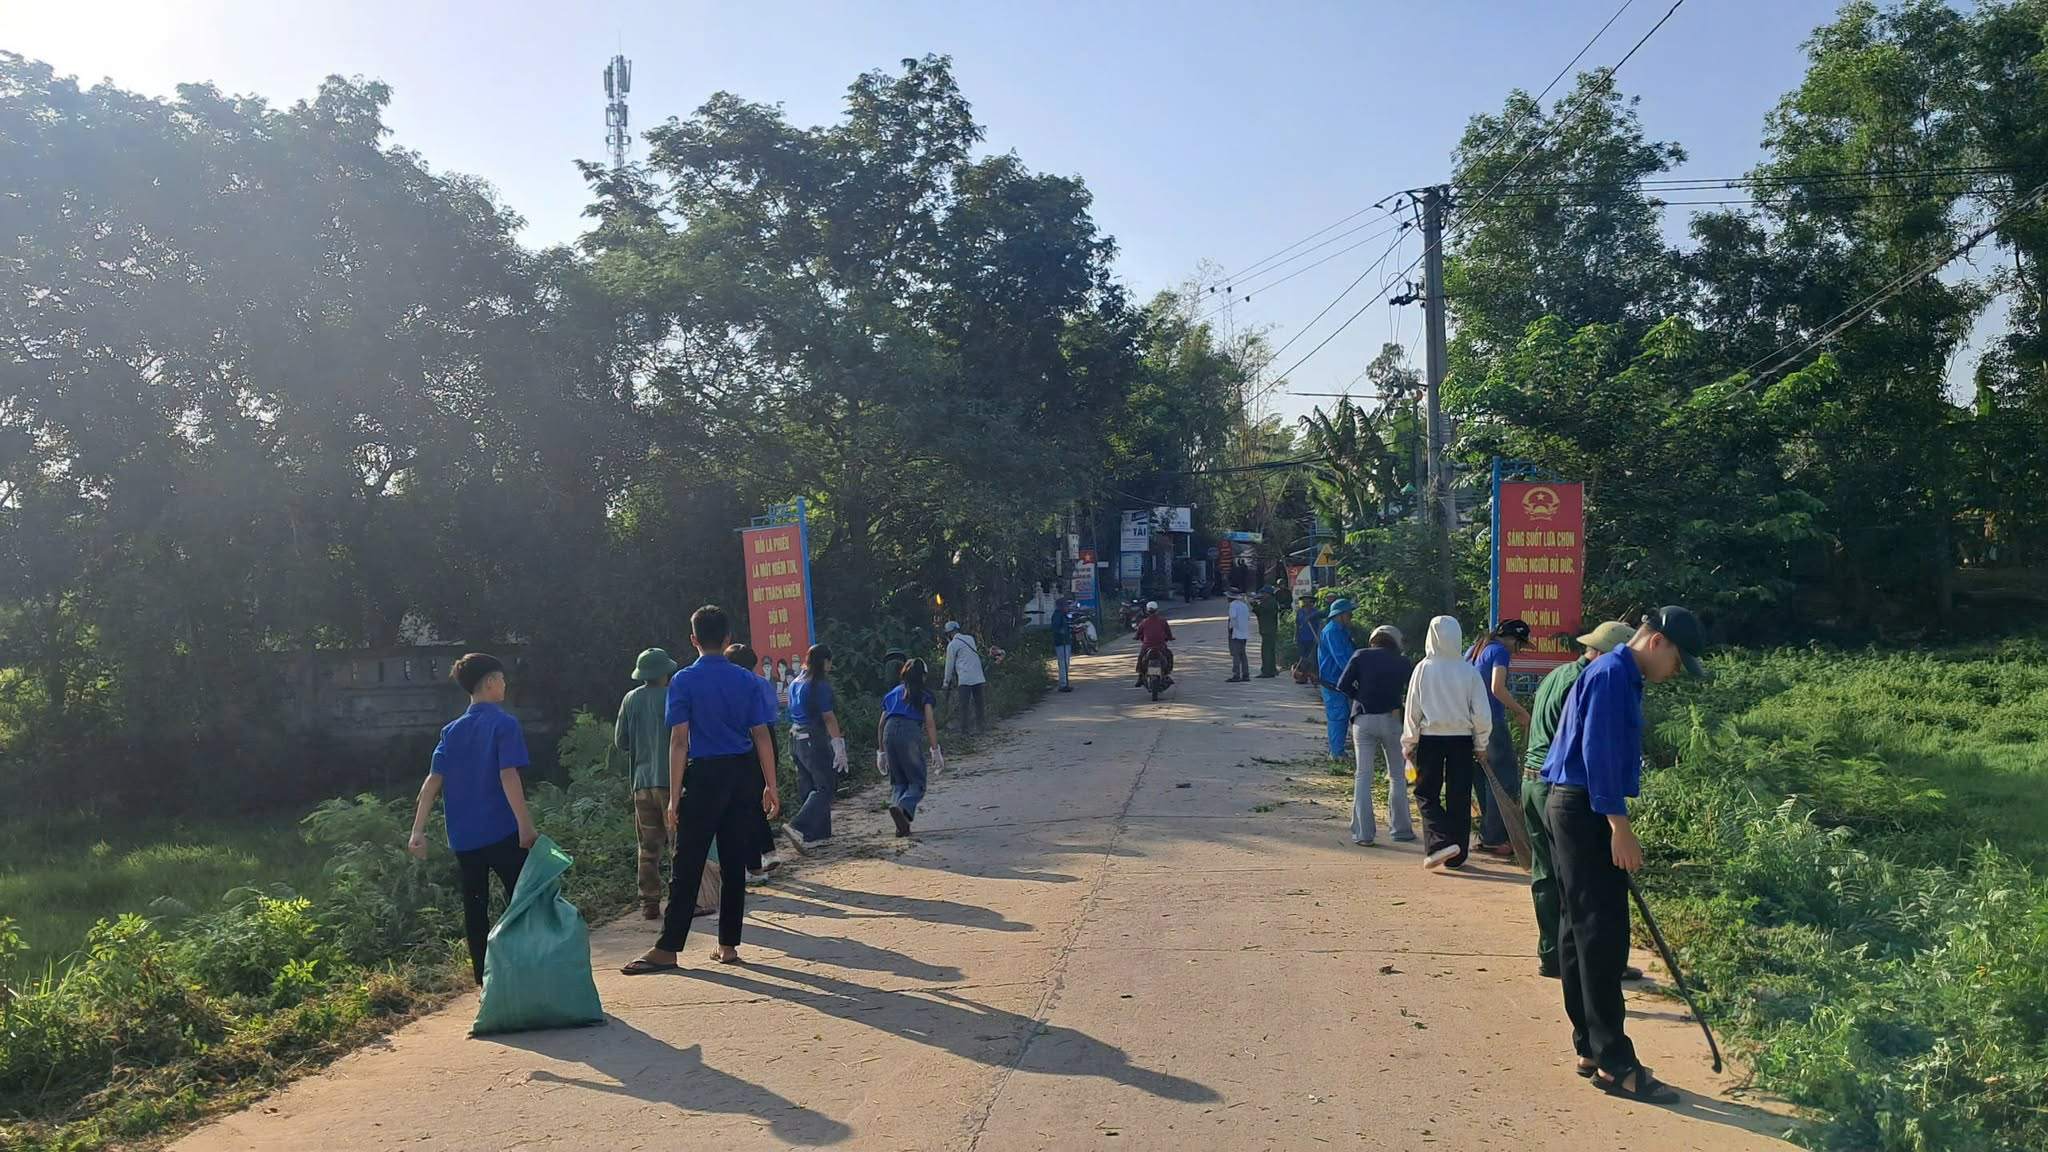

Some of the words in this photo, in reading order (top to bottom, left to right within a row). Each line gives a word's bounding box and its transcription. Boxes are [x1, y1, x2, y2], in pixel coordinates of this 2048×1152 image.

[1507, 528, 1525, 547] SÁNG
[1526, 526, 1542, 547] SUỐT
[1543, 530, 1556, 550] LỰA
[1557, 531, 1575, 550] CHỌN
[1506, 555, 1528, 573] NHỮNG
[1529, 554, 1549, 573] NGƯỜI
[1550, 553, 1559, 573] ĐỦ
[1523, 578, 1533, 600] ĐỦ
[1545, 580, 1558, 600] VÀO
[1539, 607, 1551, 629] HỘI
